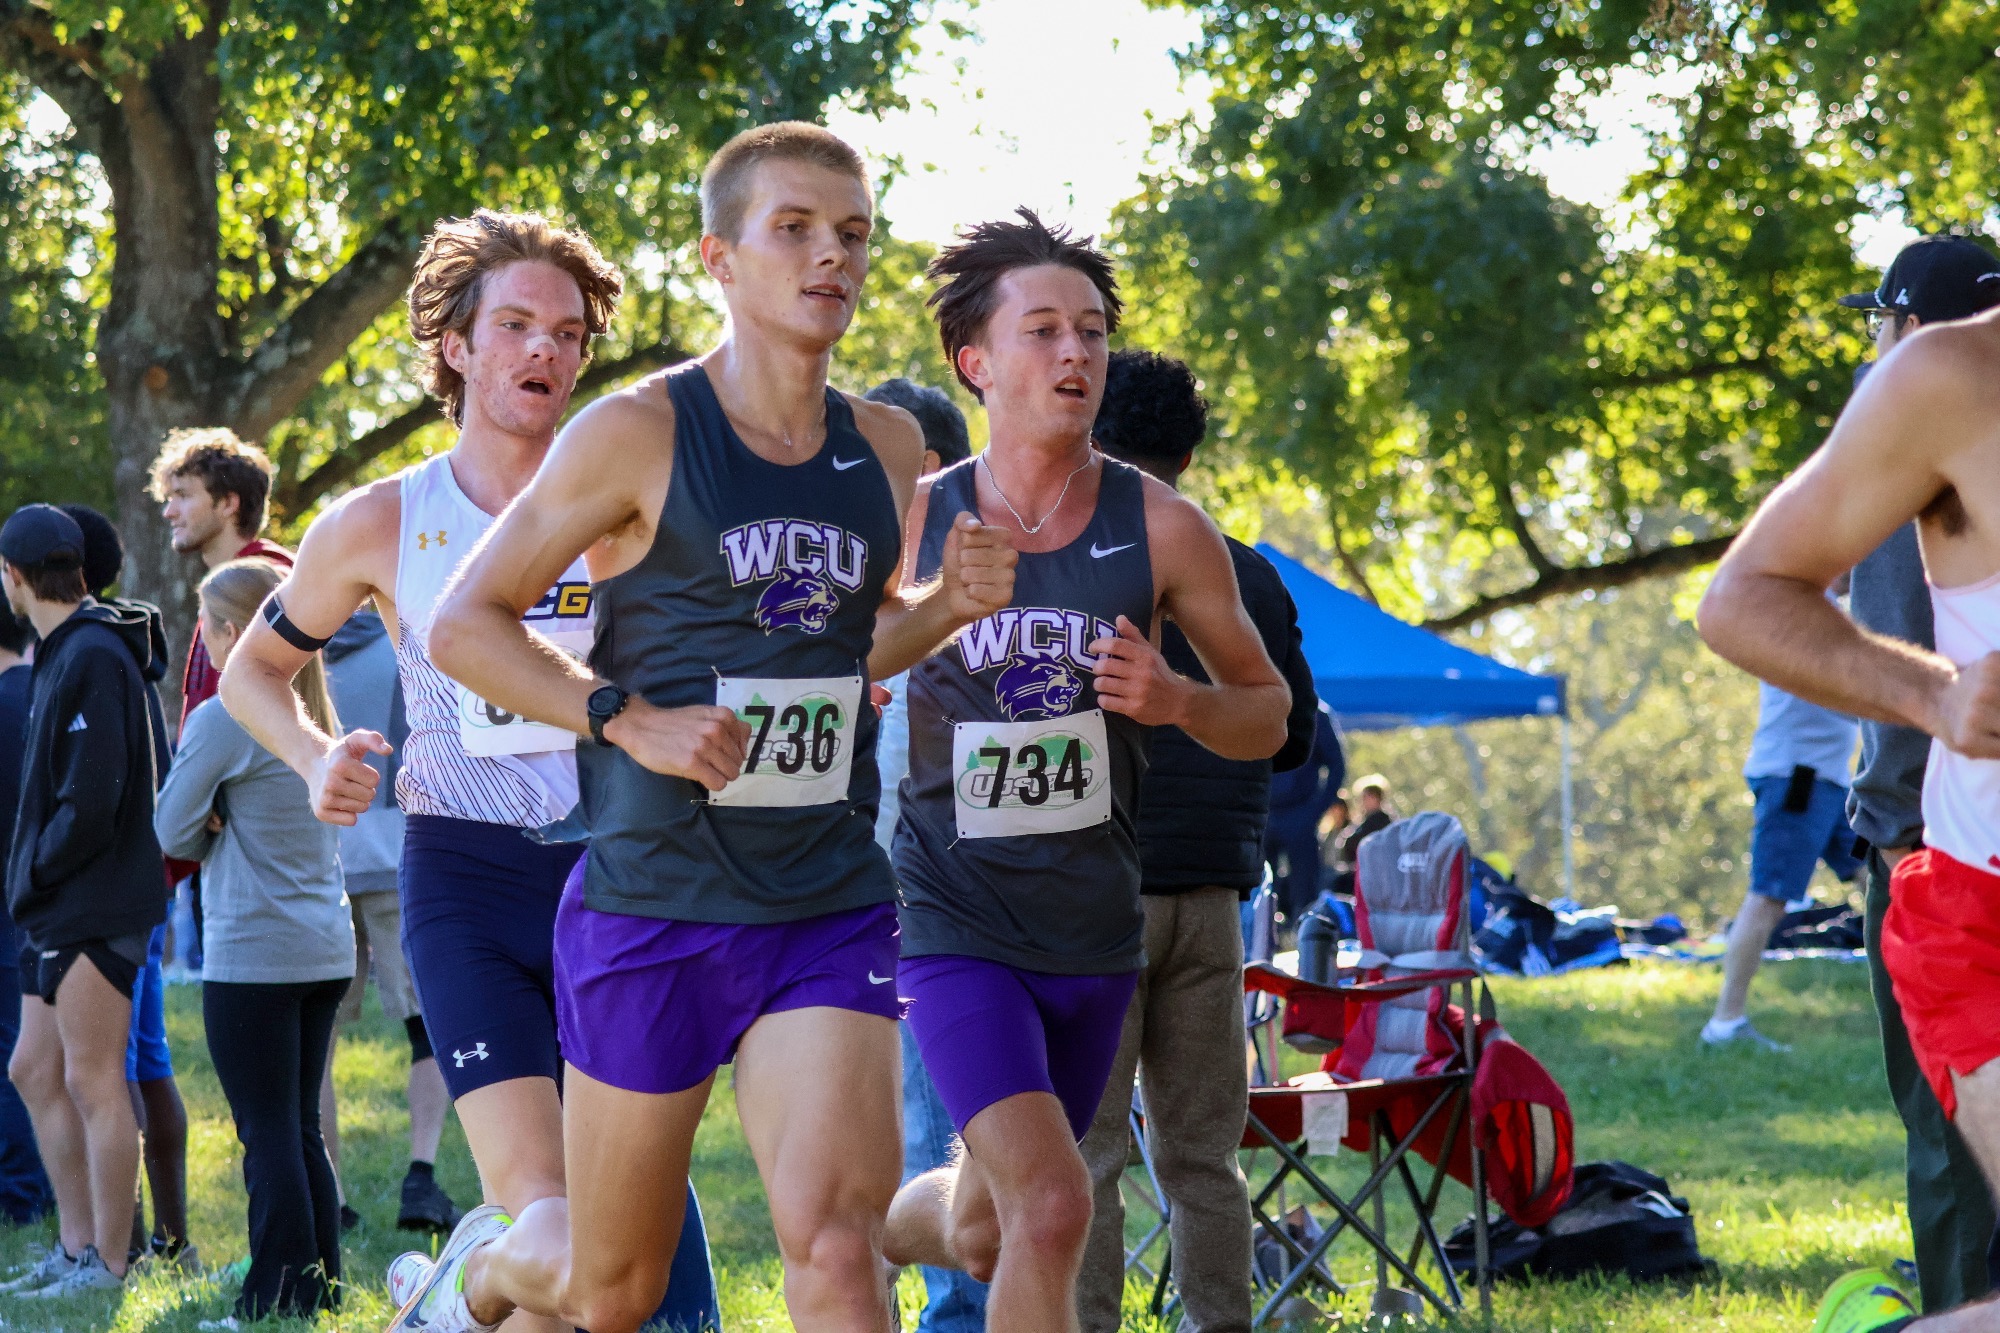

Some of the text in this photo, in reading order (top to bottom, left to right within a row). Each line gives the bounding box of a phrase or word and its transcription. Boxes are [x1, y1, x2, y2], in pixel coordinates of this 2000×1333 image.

[720, 518, 868, 593] WCU
[953, 607, 1118, 675] WCU
[745, 703, 839, 774] 736
[980, 738, 1087, 808] 734
